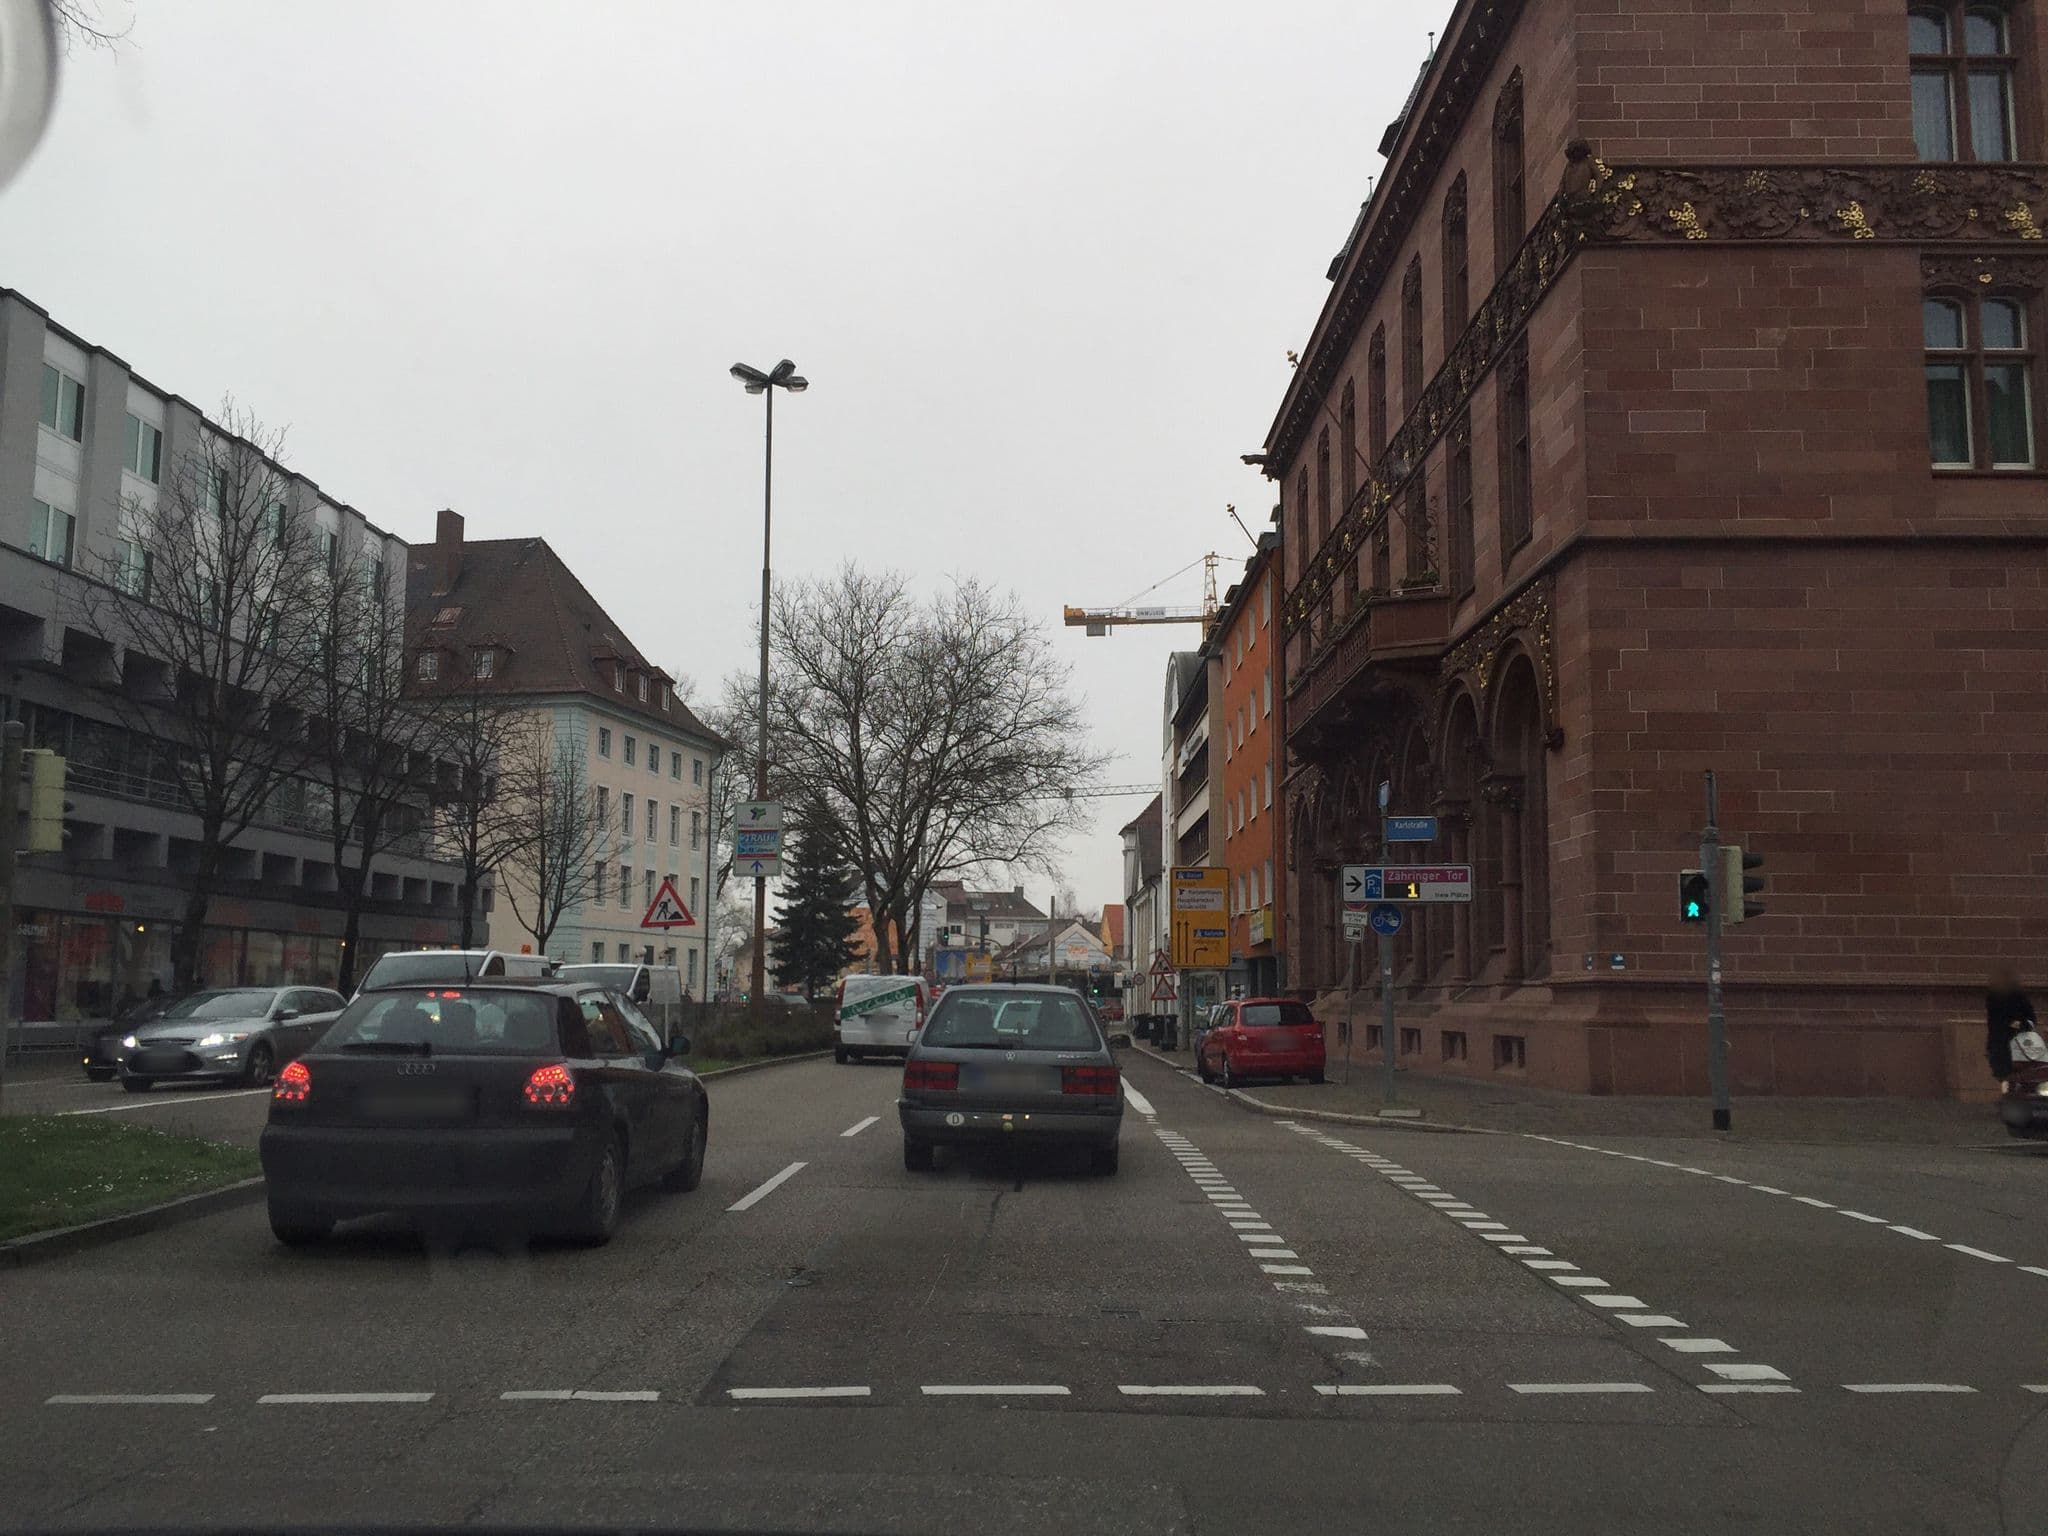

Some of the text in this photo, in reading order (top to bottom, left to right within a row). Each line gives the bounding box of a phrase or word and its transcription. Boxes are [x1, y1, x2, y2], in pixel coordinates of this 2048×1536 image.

[1388, 870, 1463, 883] Zähringer Tor
[1367, 880, 1375, 890] P
[1407, 882, 1418, 898] 1
[1372, 887, 1380, 895] 12
[952, 1114, 960, 1125] D
